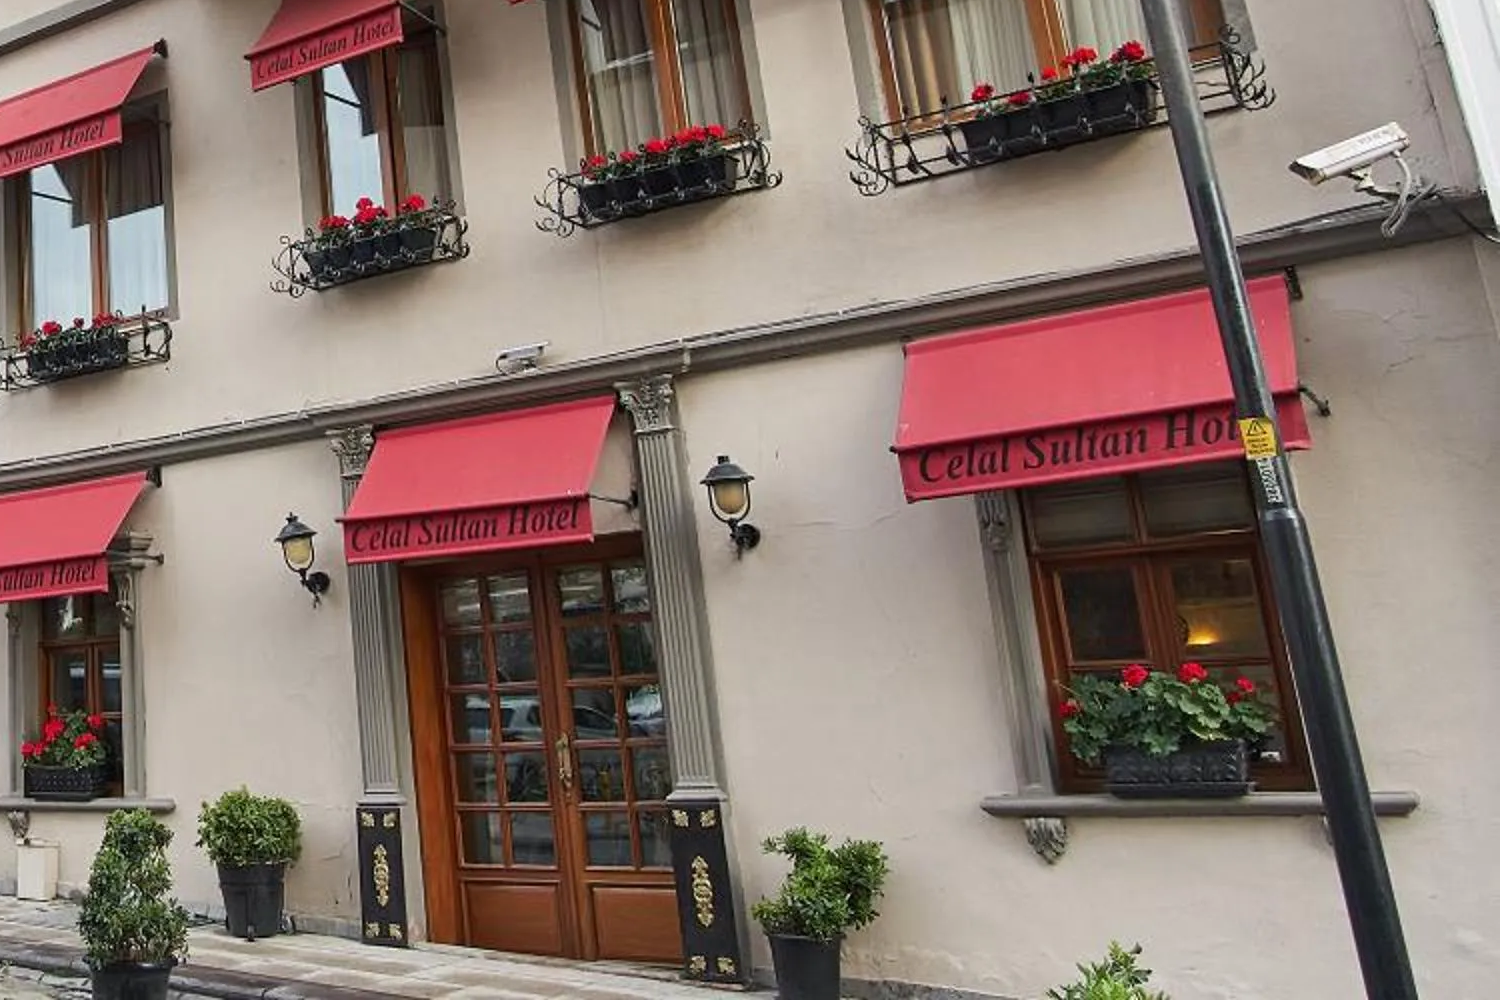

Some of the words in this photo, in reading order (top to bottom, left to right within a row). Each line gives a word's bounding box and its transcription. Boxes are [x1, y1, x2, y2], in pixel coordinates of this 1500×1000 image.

[257, 48, 295, 80] Celal
[297, 32, 347, 65] Sultan
[352, 16, 395, 44] Hotel
[2, 138, 54, 166] Sultan
[60, 120, 105, 150] Hotel
[919, 443, 1009, 482] Celal
[1023, 424, 1148, 469] Sultan
[1166, 408, 1238, 448] Hot
[352, 521, 409, 551] Celal
[418, 514, 497, 545] Sultan
[507, 501, 579, 536] Hotel
[51, 560, 96, 584] Hotel
